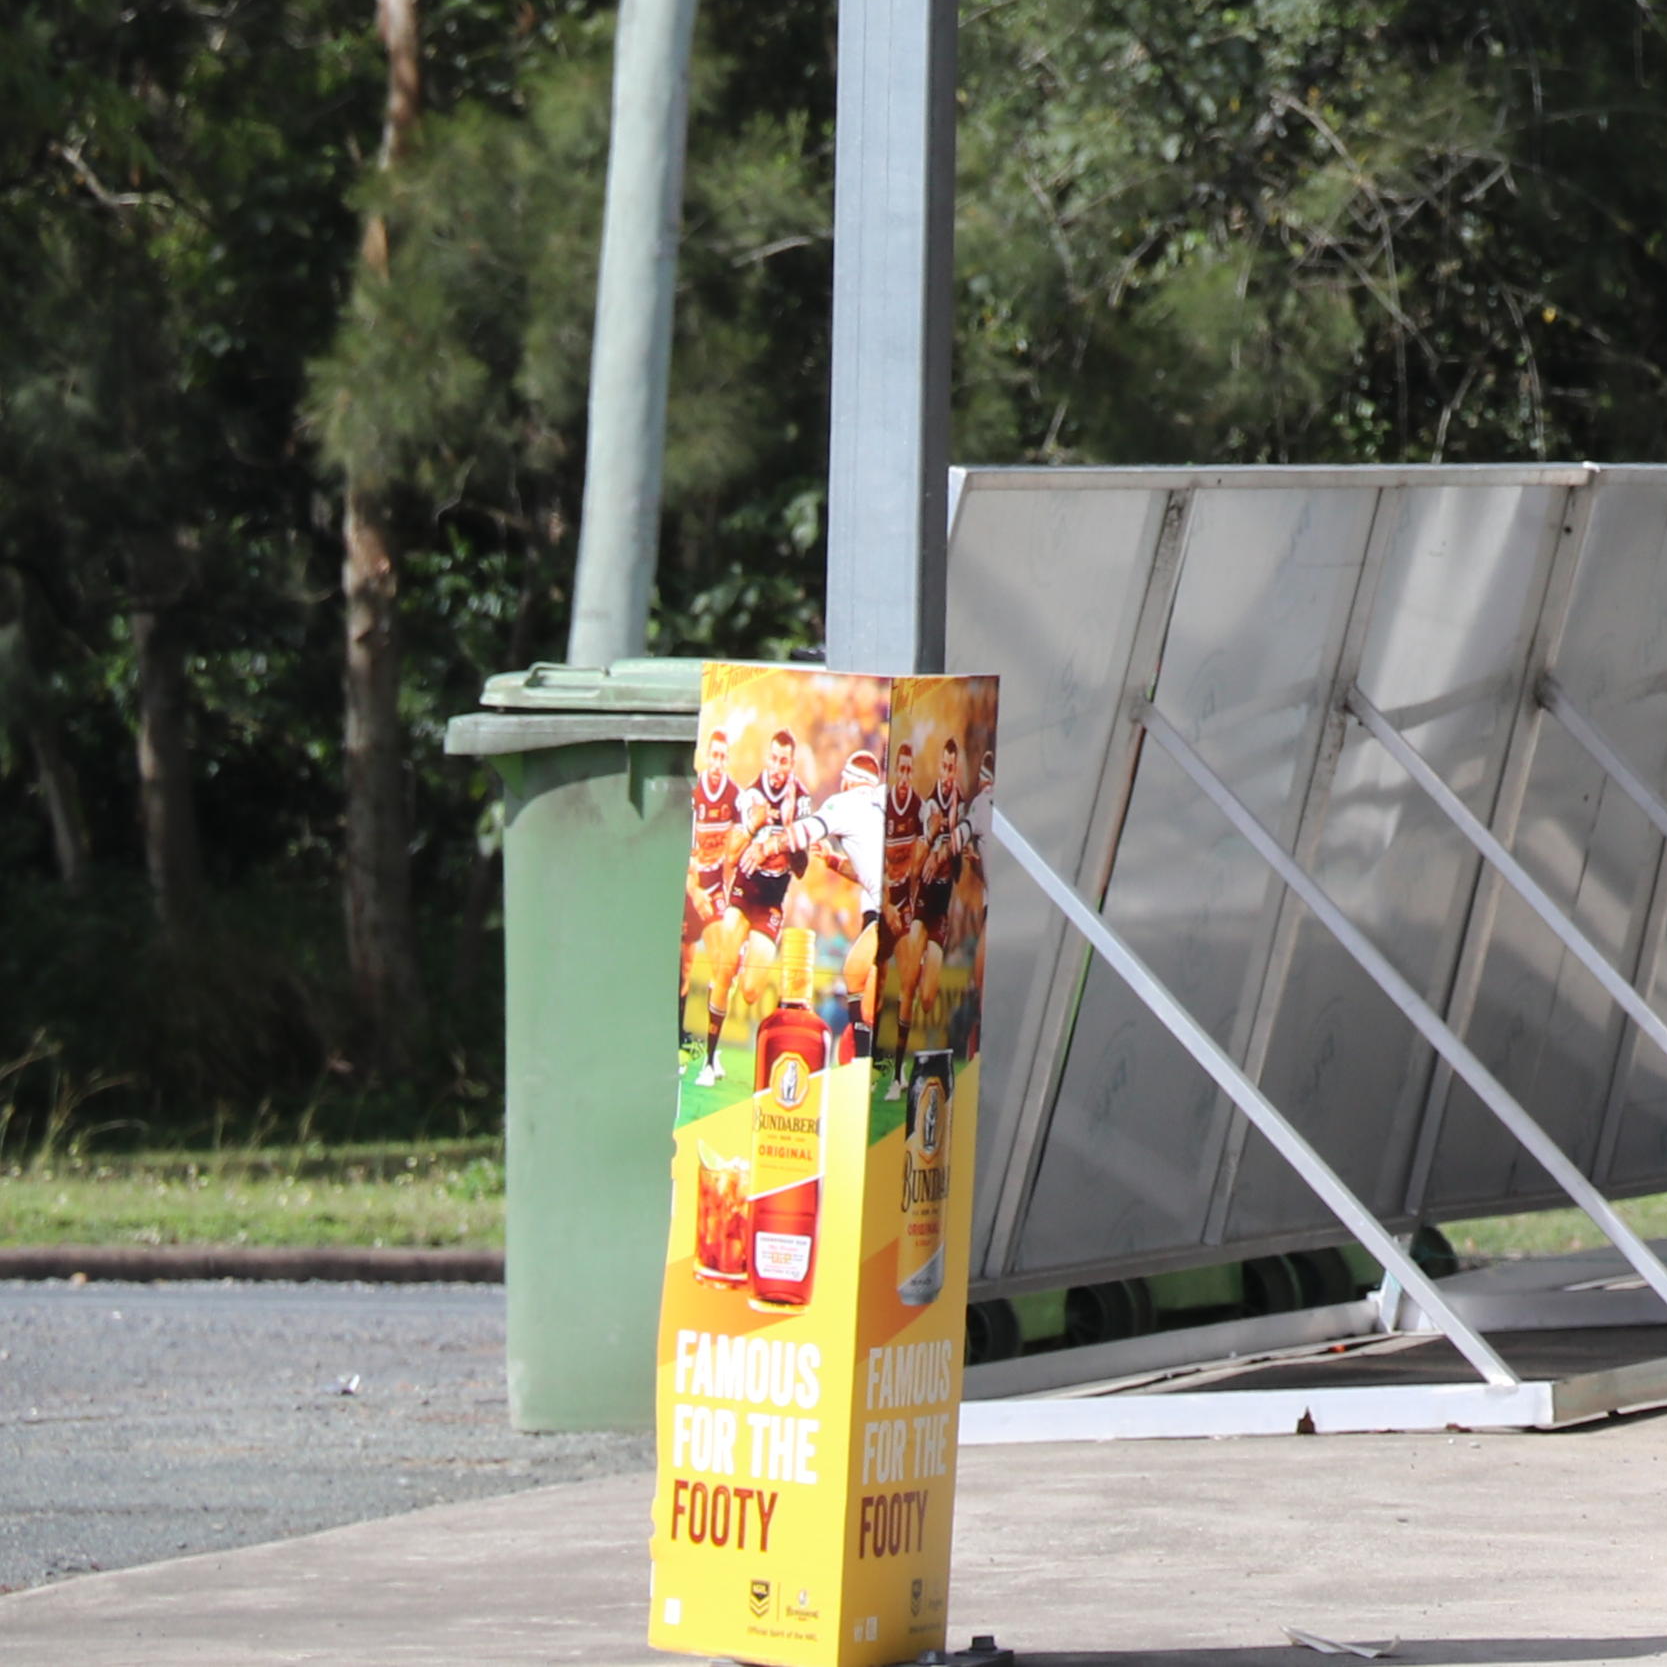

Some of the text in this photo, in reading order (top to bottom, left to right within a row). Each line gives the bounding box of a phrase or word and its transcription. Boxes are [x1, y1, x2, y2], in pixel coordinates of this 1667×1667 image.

[758, 1144, 814, 1161] ORIGINAL
[674, 1329, 821, 1411] FAMOUS
[866, 1339, 952, 1411] FAMOUS
[672, 1404, 819, 1485] FOR THE
[862, 1413, 949, 1487] FOR THE
[671, 1479, 779, 1553] FOOTY
[859, 1490, 930, 1559] FOOTY
